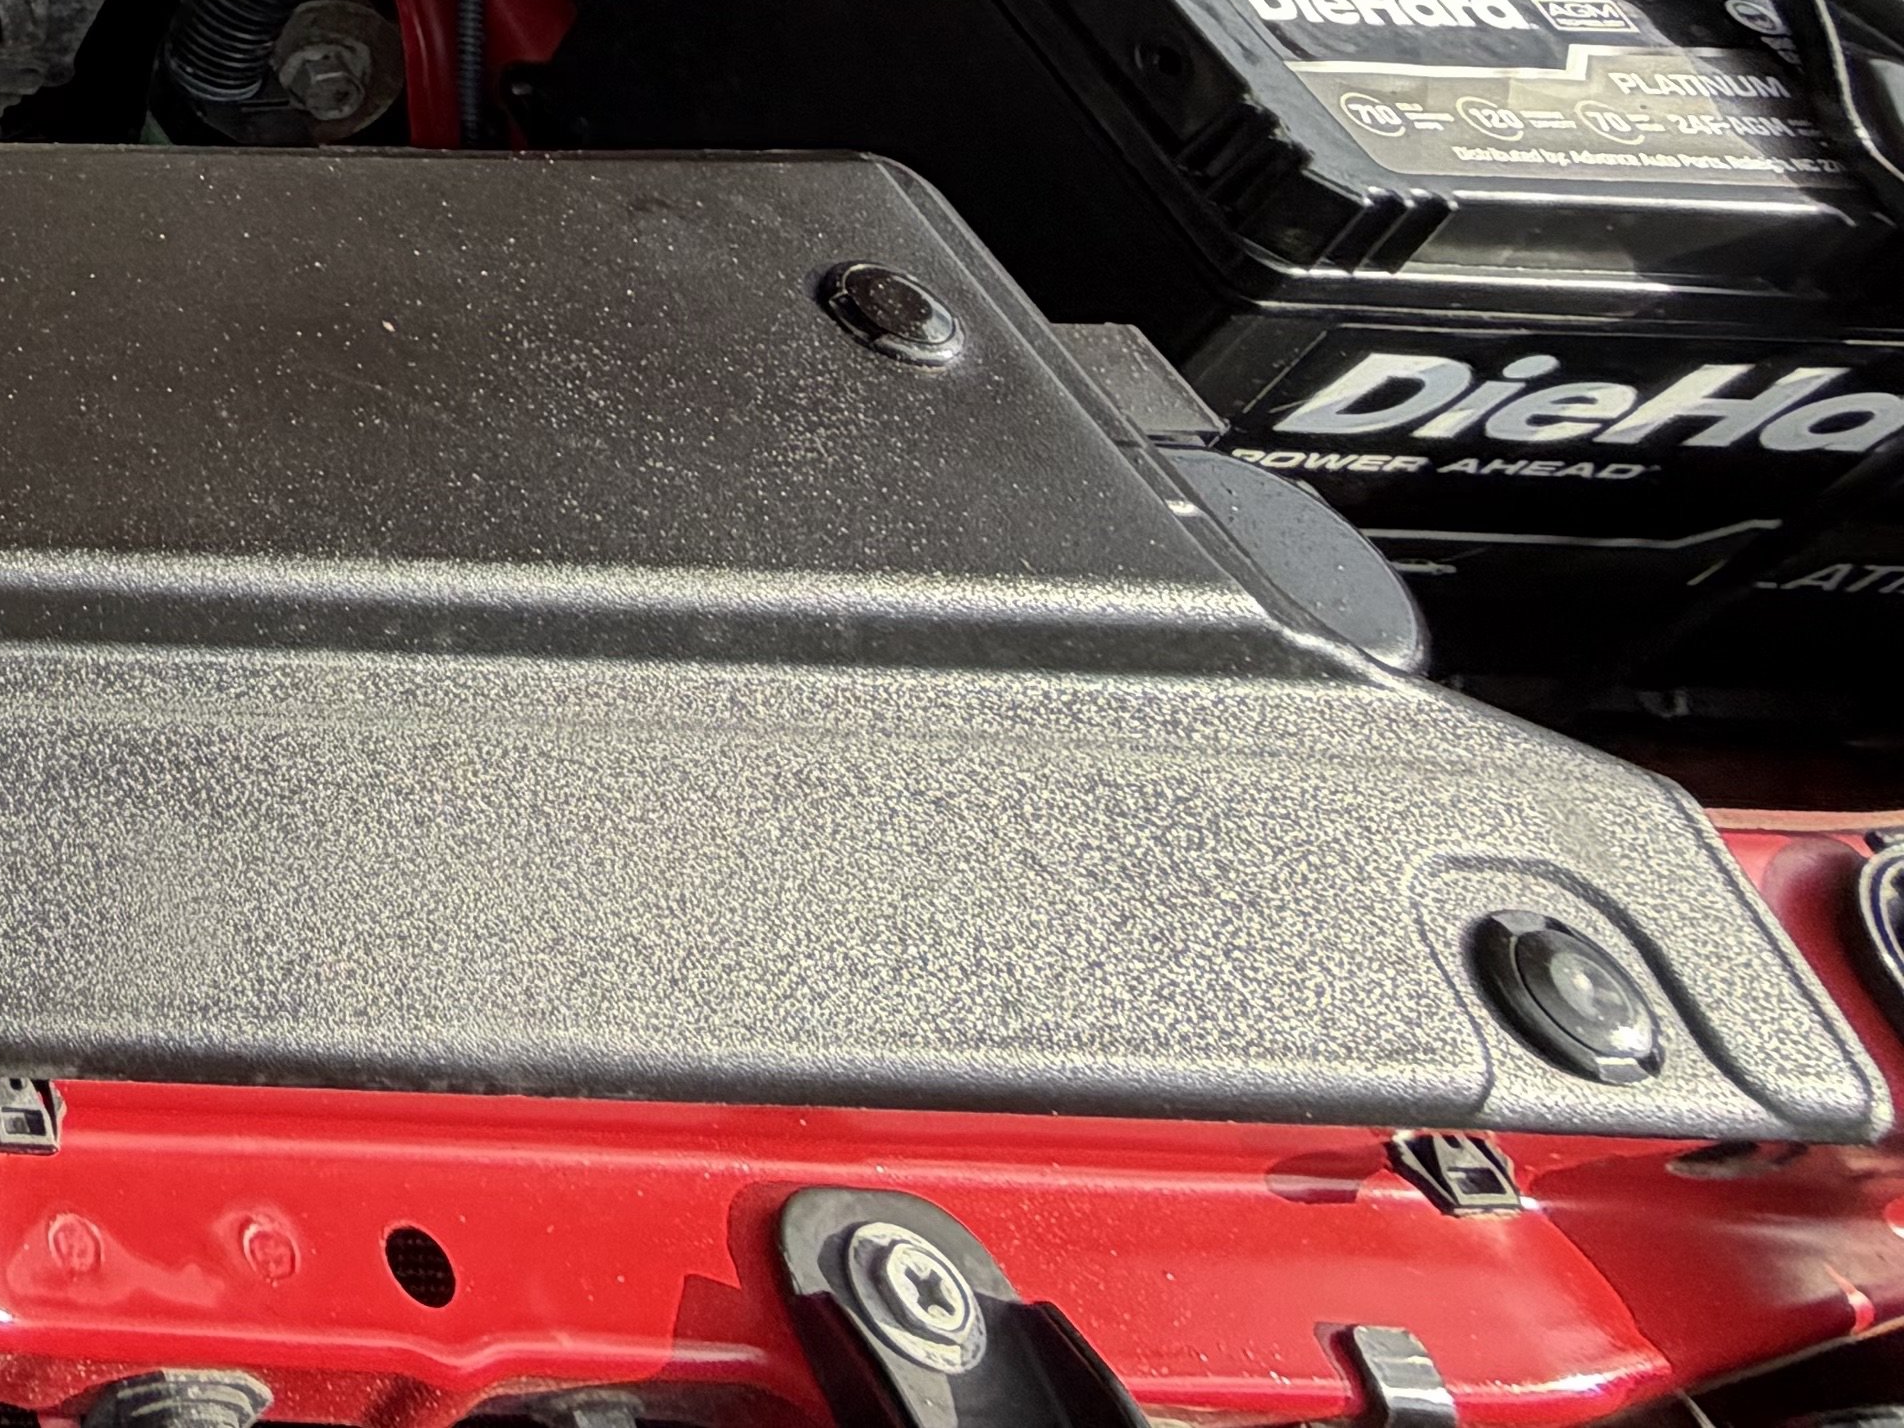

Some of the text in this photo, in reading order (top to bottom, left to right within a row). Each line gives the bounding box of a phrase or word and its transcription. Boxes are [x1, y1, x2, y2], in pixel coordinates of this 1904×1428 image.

[1548, 2, 1620, 19] AGM
[1607, 72, 1792, 98] PLATINUM
[1347, 103, 1403, 126] 710
[1467, 108, 1525, 129] 120
[1584, 111, 1633, 132] 70
[1666, 113, 1796, 137] 24F-AGM
[1435, 458, 1645, 481] AHEAD
